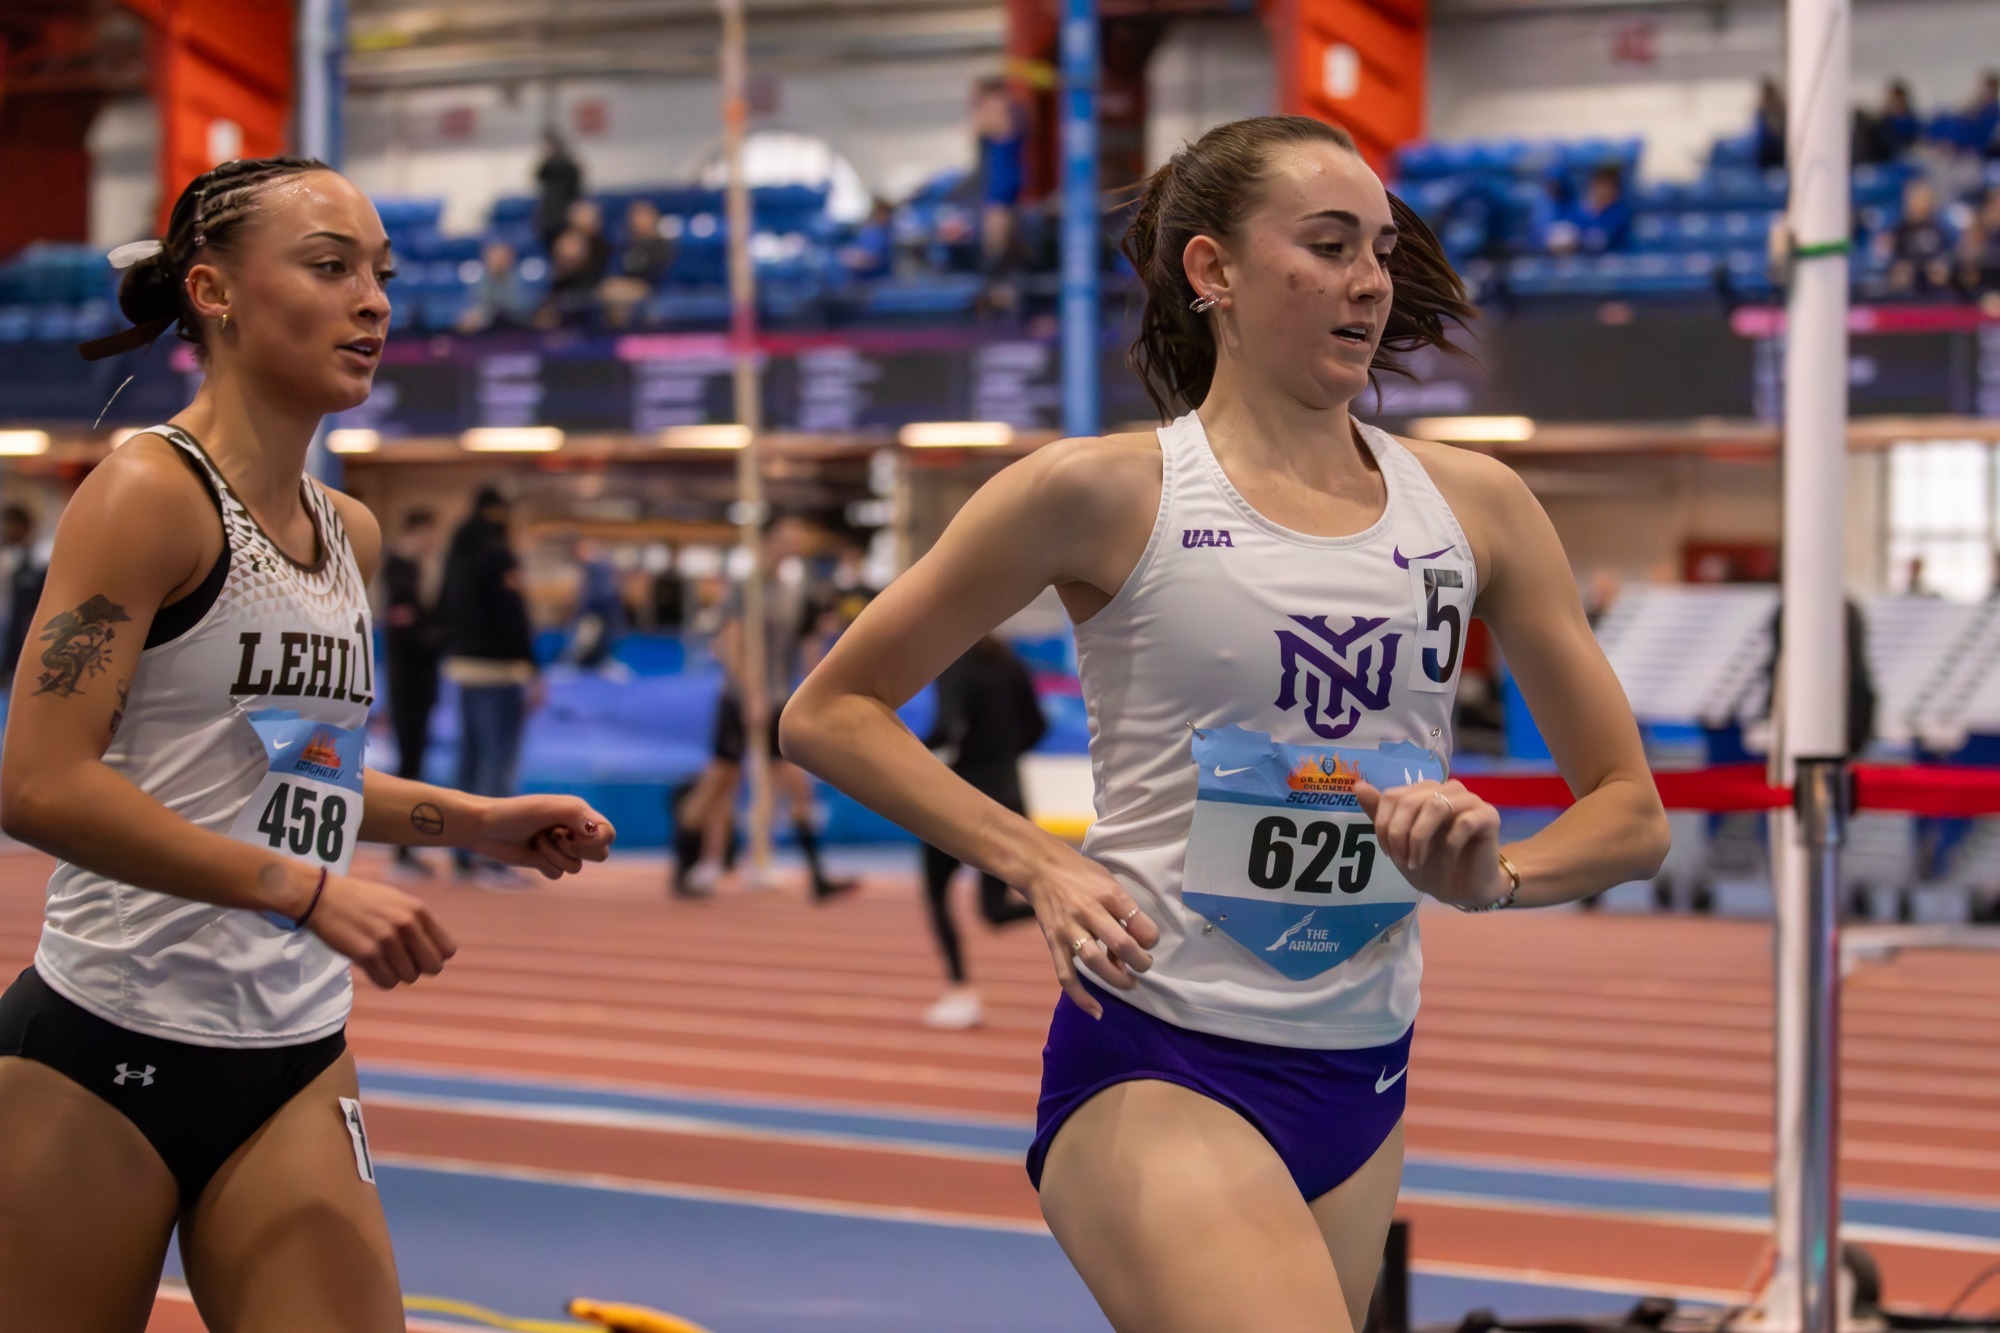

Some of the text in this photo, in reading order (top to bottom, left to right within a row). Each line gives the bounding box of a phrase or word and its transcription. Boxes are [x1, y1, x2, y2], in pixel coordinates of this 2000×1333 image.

[1181, 529, 1235, 548] UAA
[1422, 568, 1464, 684] 5
[1286, 791, 1360, 807] SCORCHE
[257, 782, 347, 863] 458
[1247, 815, 1376, 894] 625
[1306, 928, 1329, 940] THE
[1288, 940, 1341, 953] ARMORY
